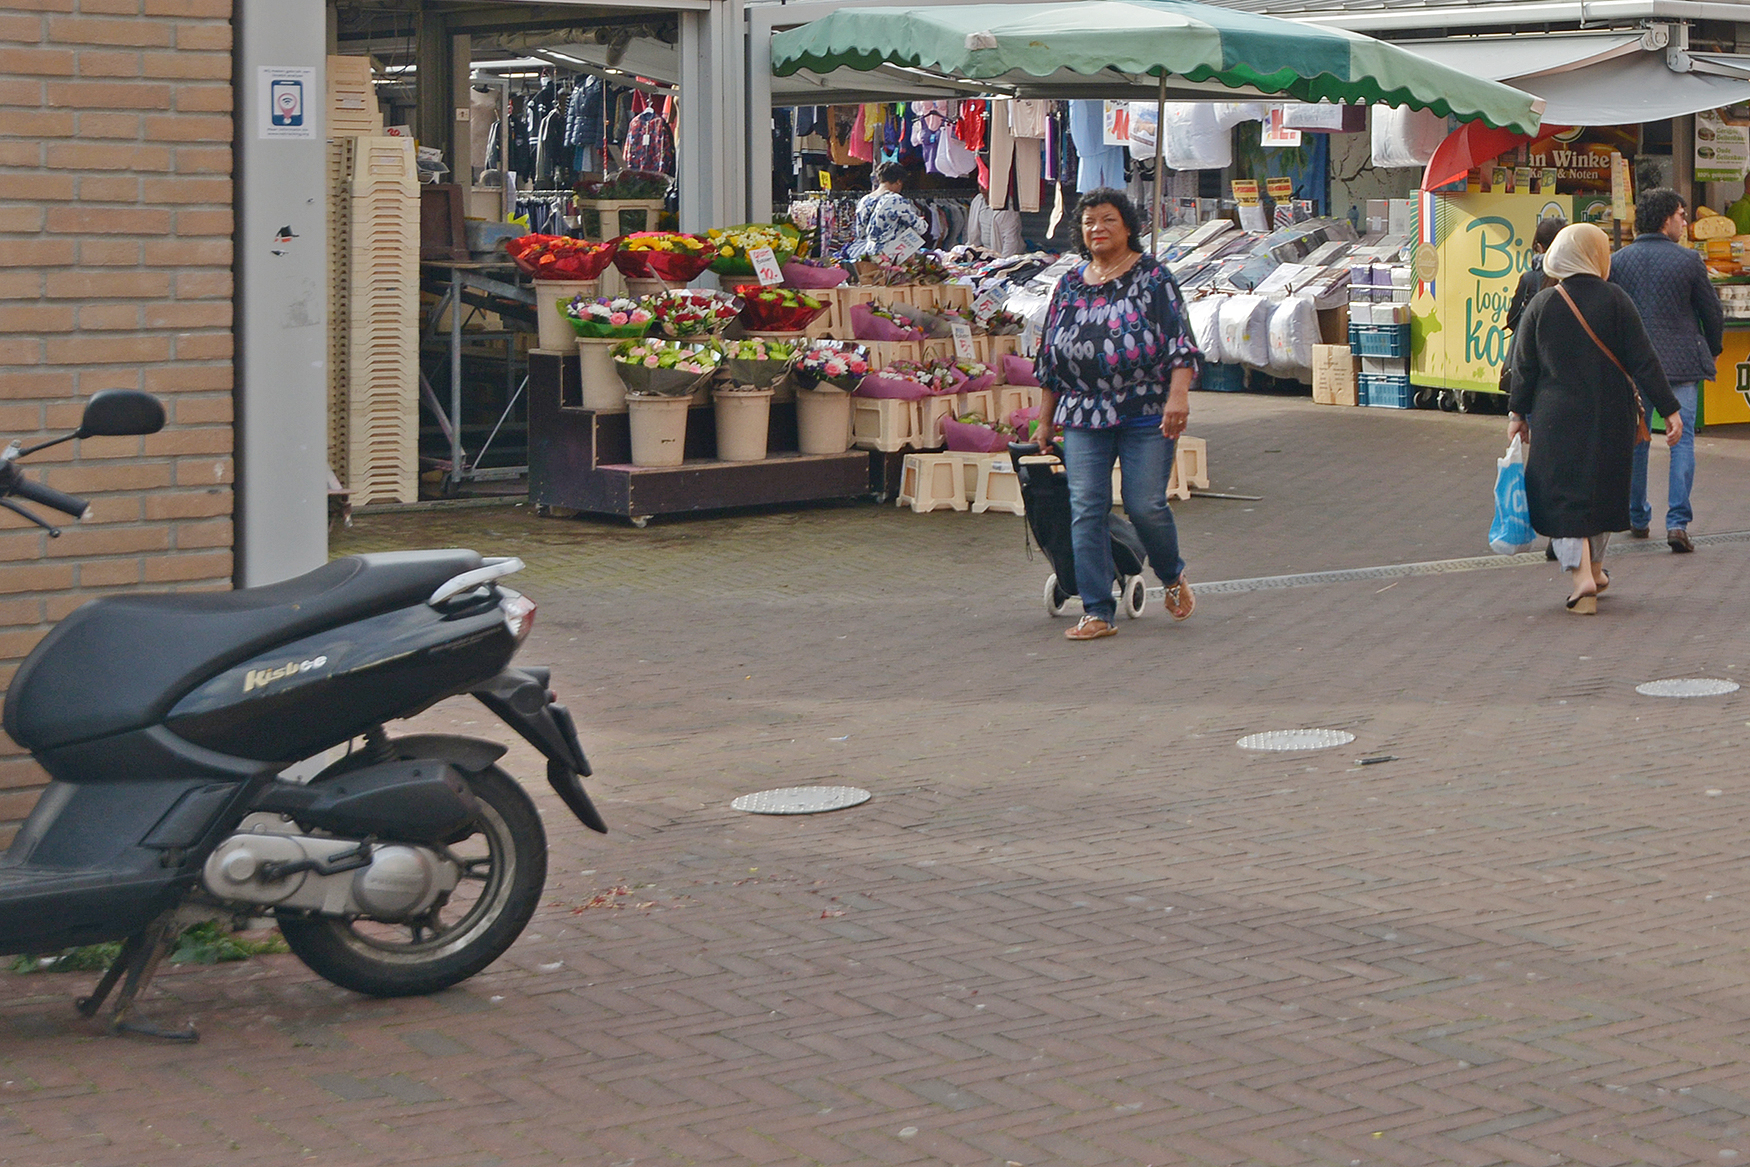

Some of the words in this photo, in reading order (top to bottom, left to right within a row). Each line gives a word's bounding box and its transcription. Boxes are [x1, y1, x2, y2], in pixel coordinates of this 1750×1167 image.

[1528, 153, 1546, 167] an
[1552, 150, 1612, 168] Winke
[1568, 168, 1599, 180] Noten
[243, 655, 328, 693] Kisbee
